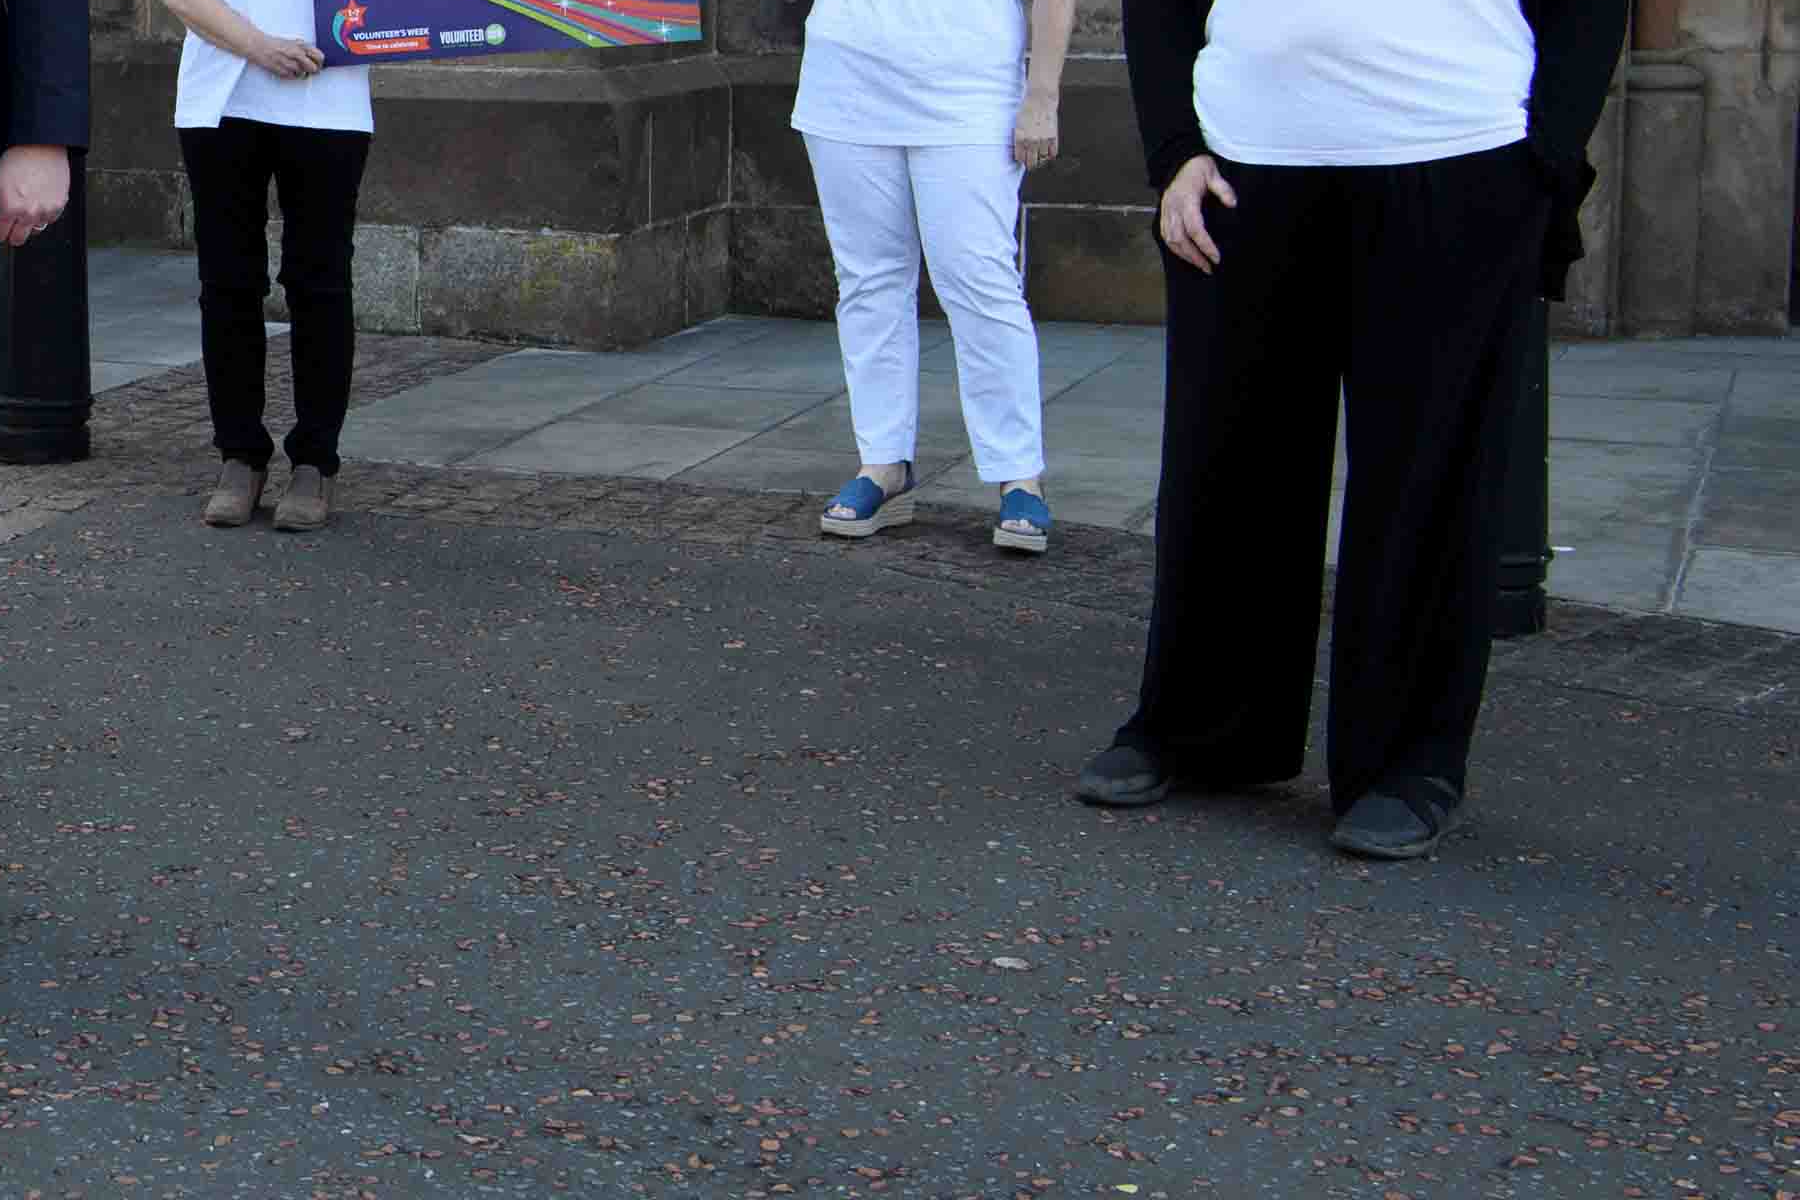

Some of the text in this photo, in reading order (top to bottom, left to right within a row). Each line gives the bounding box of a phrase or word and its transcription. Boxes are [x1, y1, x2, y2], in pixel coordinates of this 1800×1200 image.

[353, 28, 429, 41] VOLUNTEER'S WEEK
[440, 29, 484, 44] VOLUNTEER
